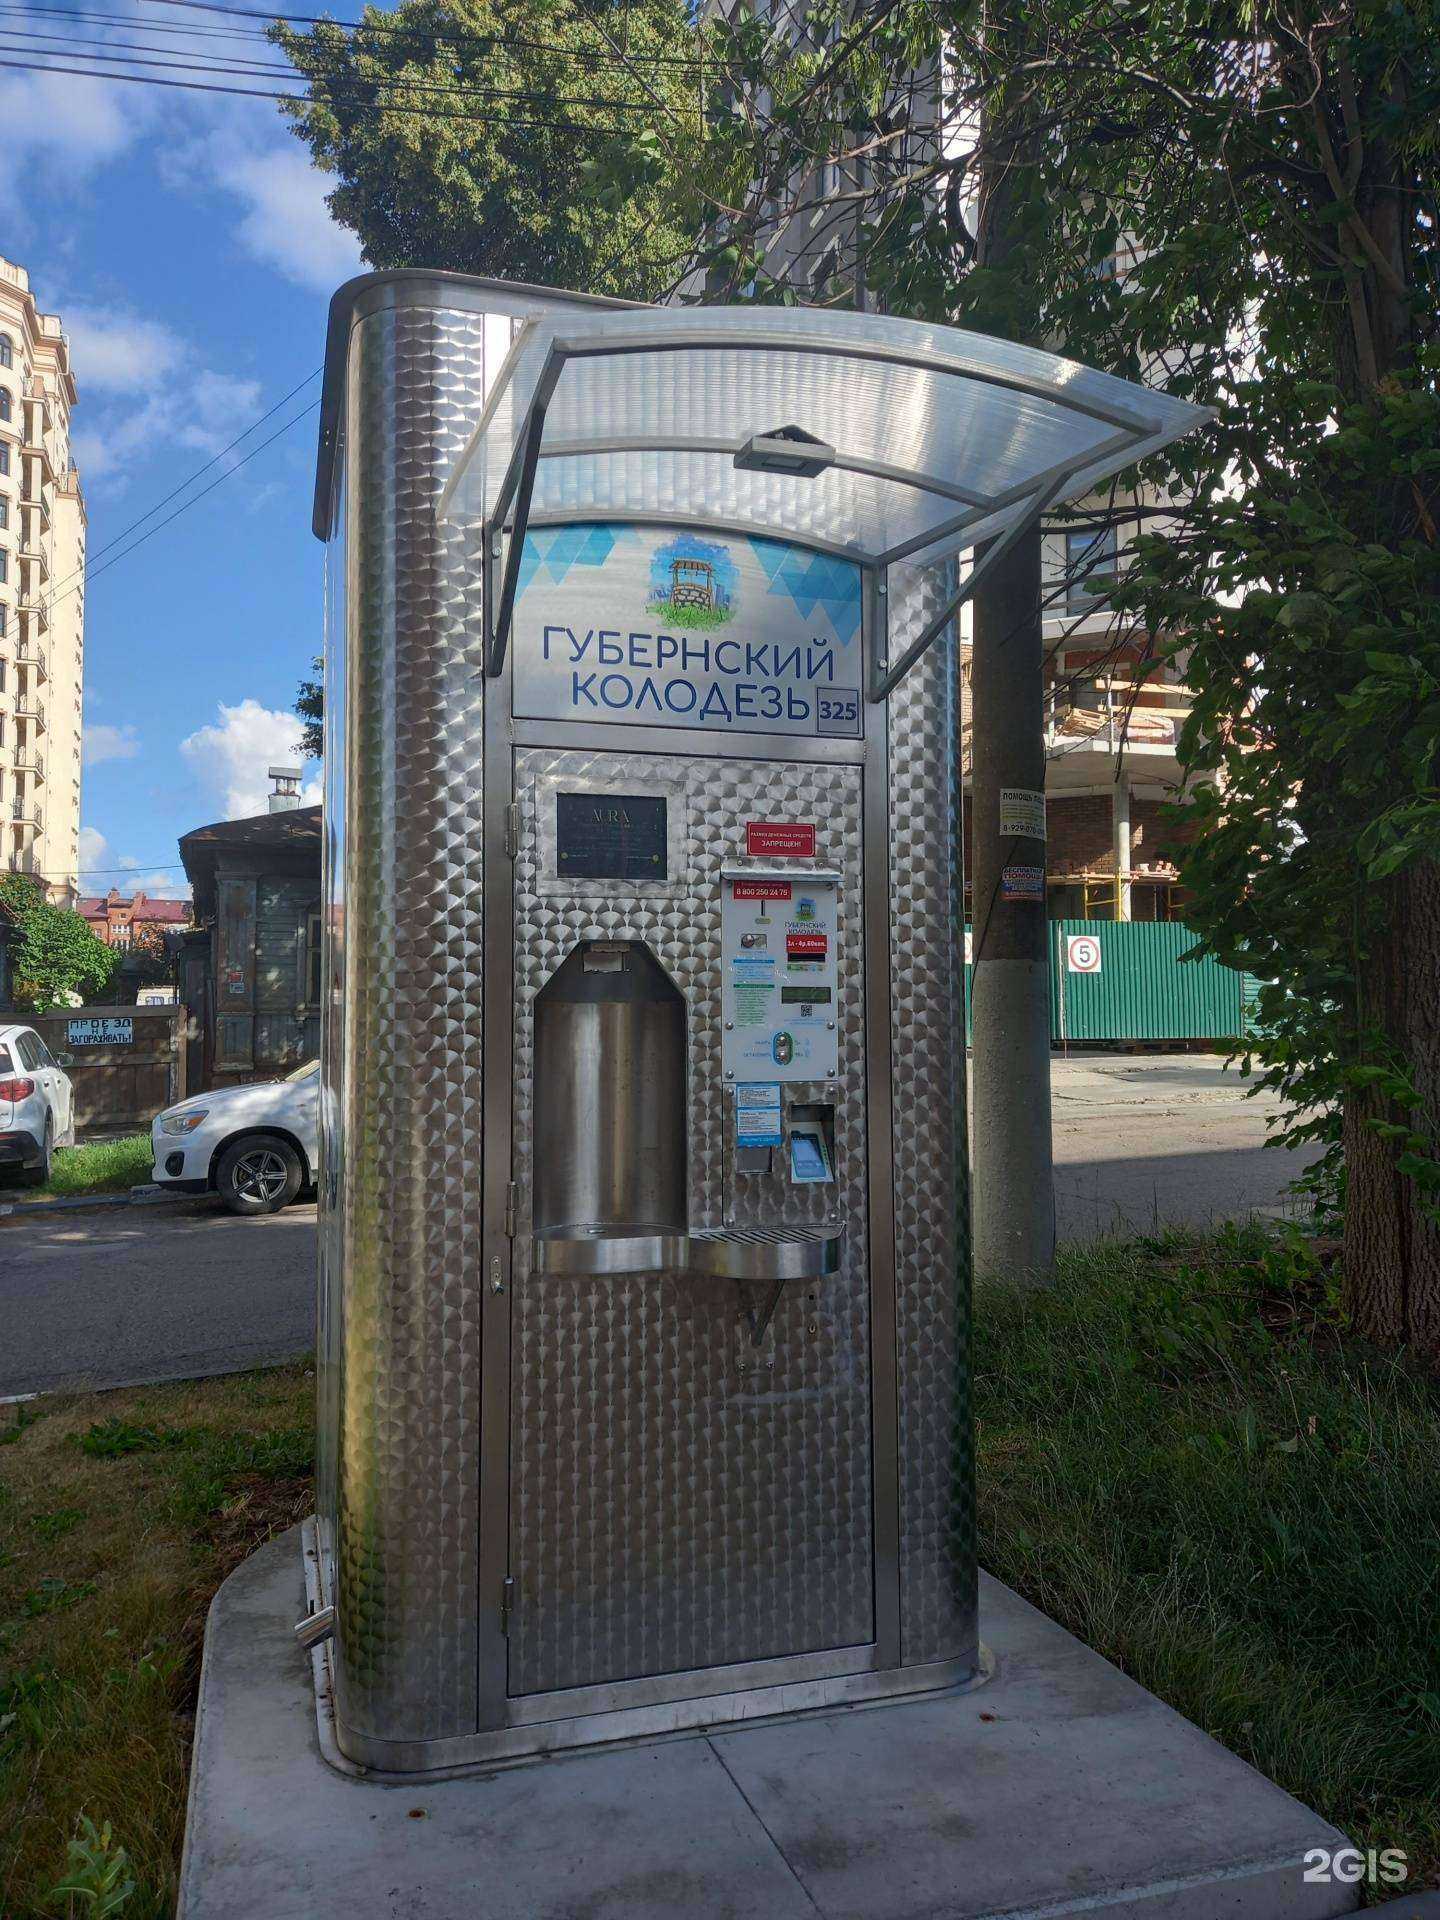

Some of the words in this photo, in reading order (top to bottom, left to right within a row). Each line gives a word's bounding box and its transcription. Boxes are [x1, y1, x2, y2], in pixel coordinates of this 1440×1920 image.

[543, 625, 833, 682] ГУБЕРНСКИЙ
[572, 671, 810, 723] КОЛОДЕЗЬ
[819, 701, 857, 721] 325
[1079, 945, 1091, 963] 5
[91, 1027, 109, 1035] НЕ
